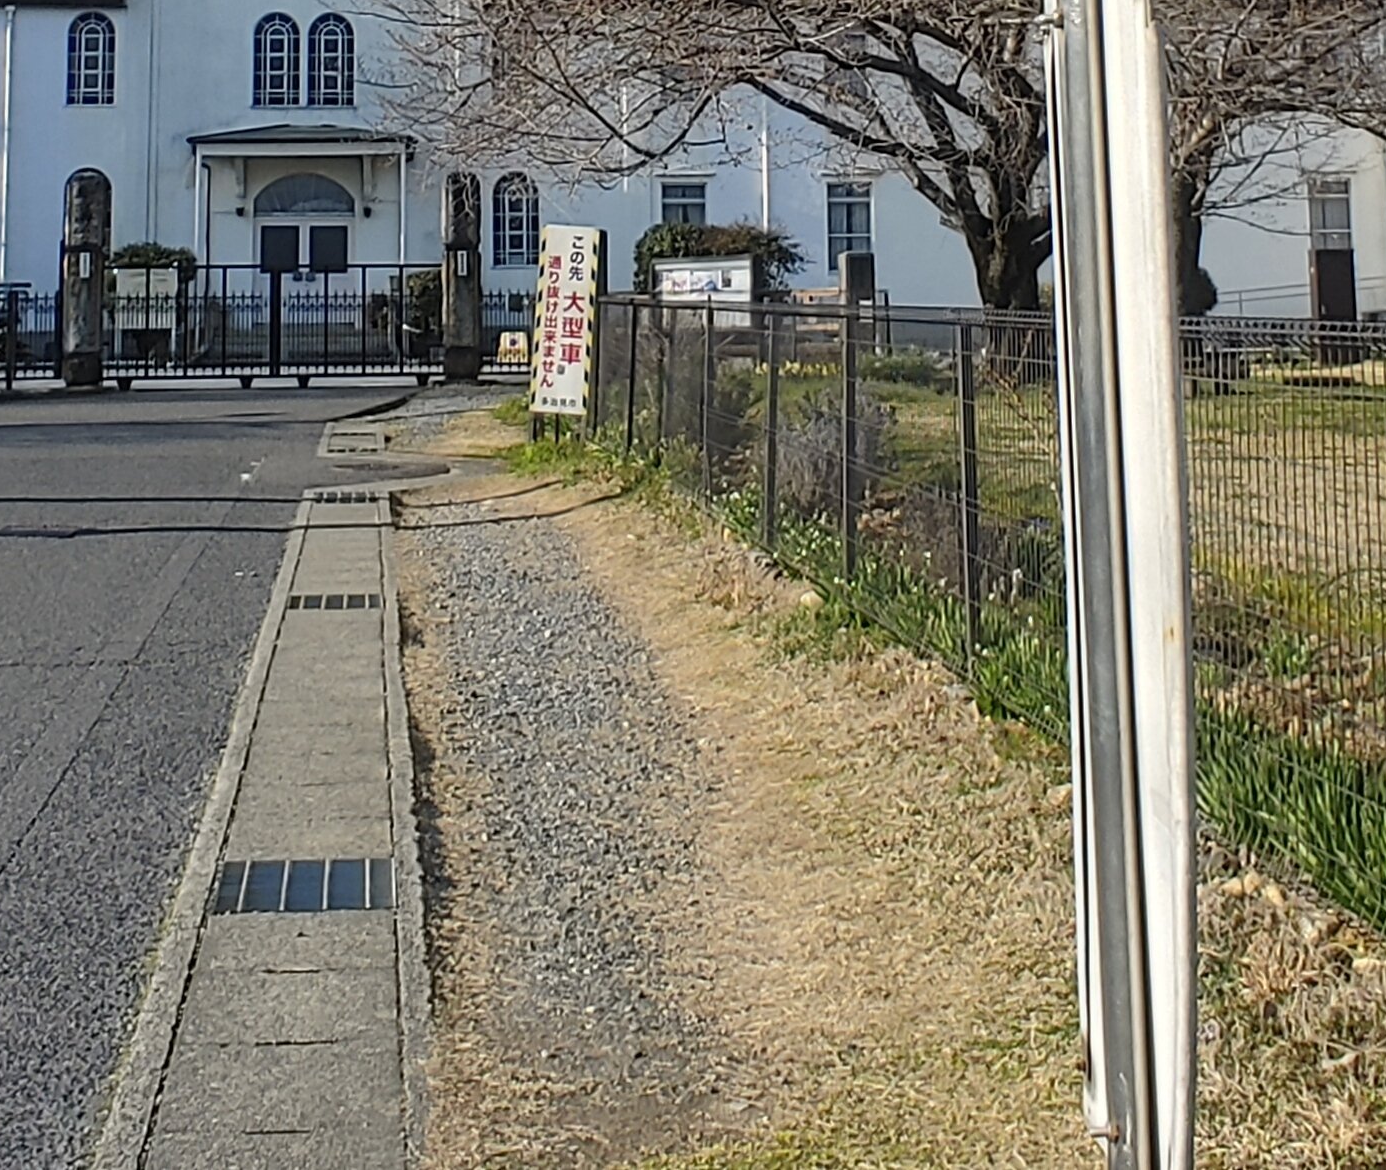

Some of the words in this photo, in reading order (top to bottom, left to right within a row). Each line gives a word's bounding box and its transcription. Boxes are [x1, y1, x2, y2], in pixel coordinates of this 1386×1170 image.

[568, 235, 585, 282] この先
[539, 255, 562, 389] 通り抜け出来ません
[559, 291, 585, 365] 大型車
